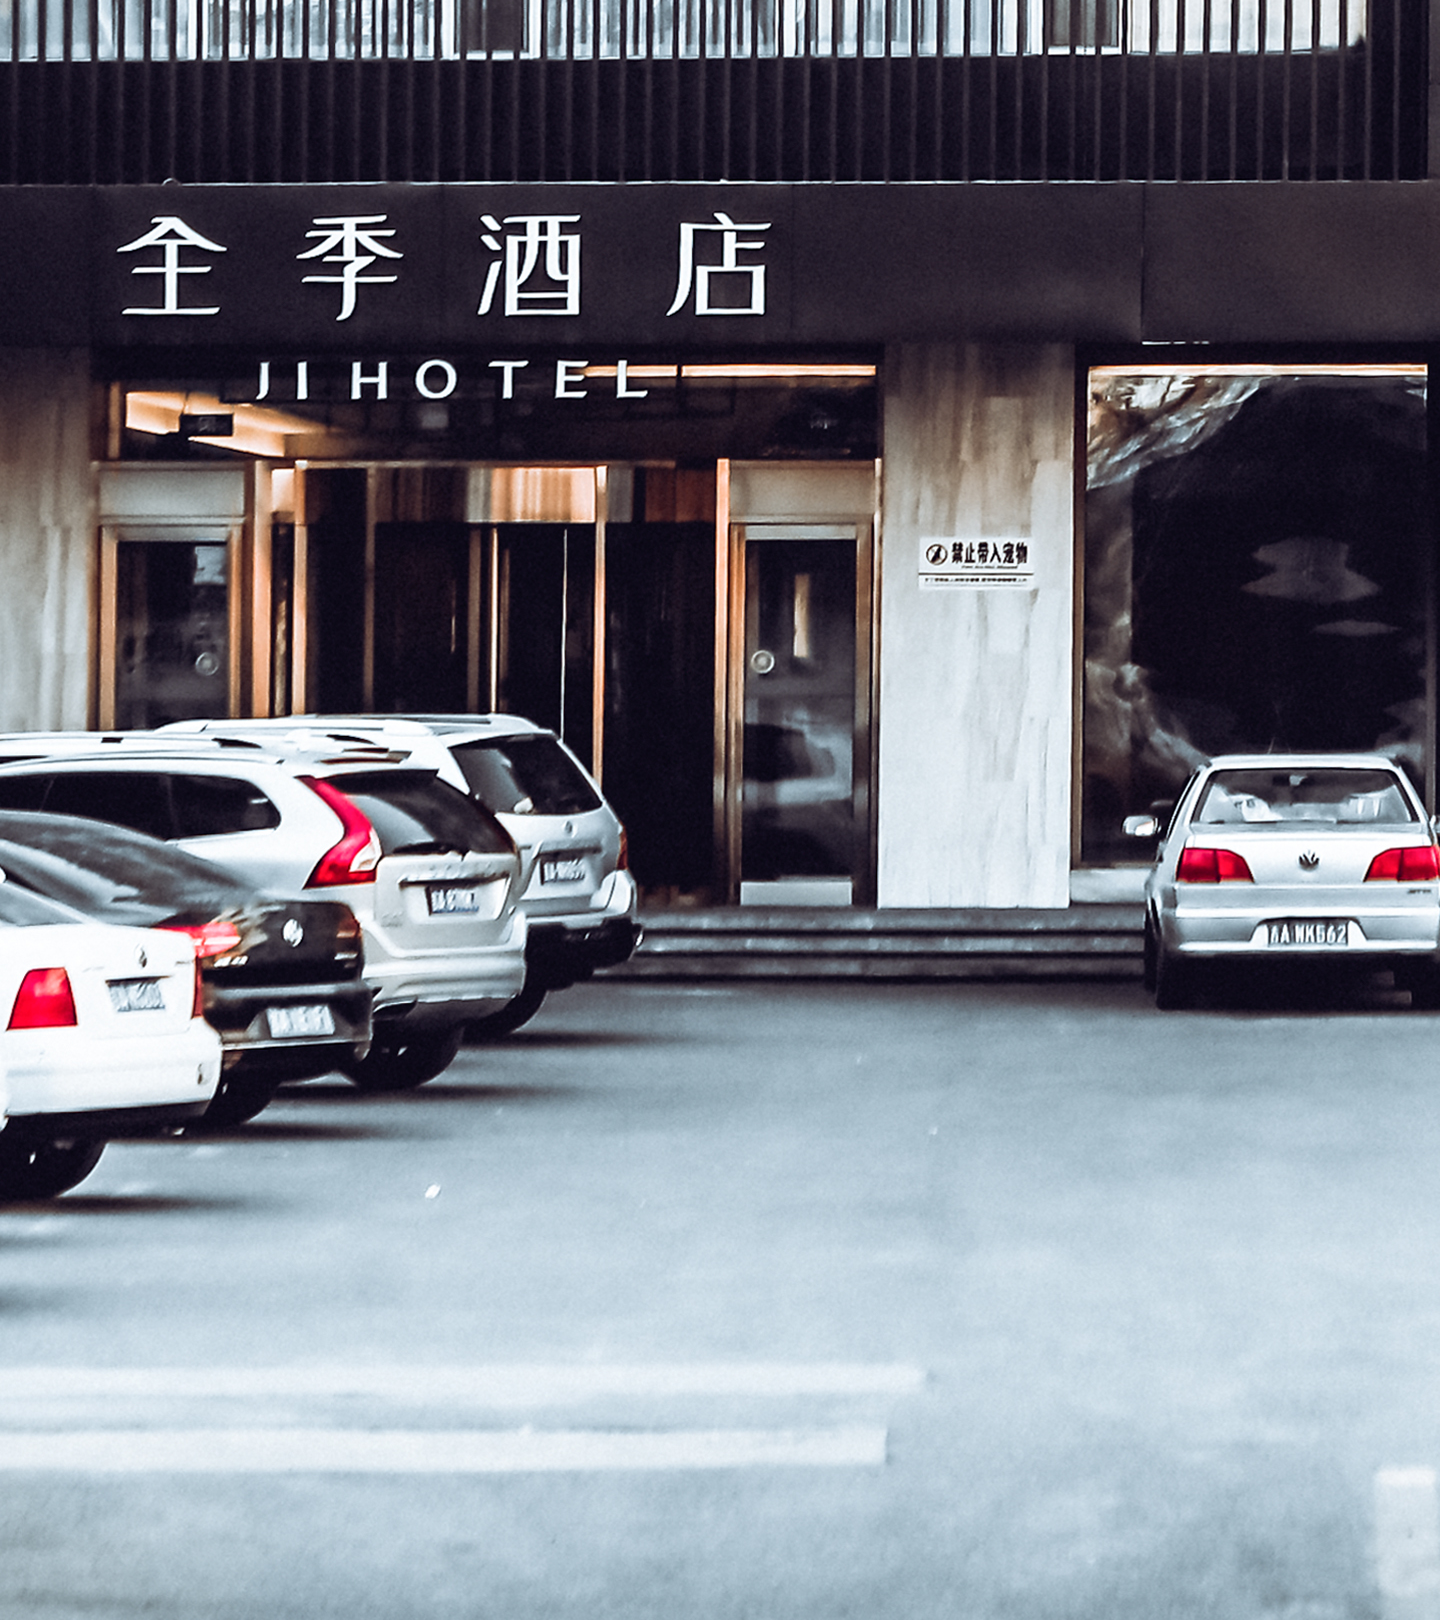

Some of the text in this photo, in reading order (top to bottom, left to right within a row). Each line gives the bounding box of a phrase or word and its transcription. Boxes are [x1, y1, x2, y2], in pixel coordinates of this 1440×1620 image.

[116, 212, 772, 321] 全季酒店
[256, 359, 648, 400] JI HOTEL
